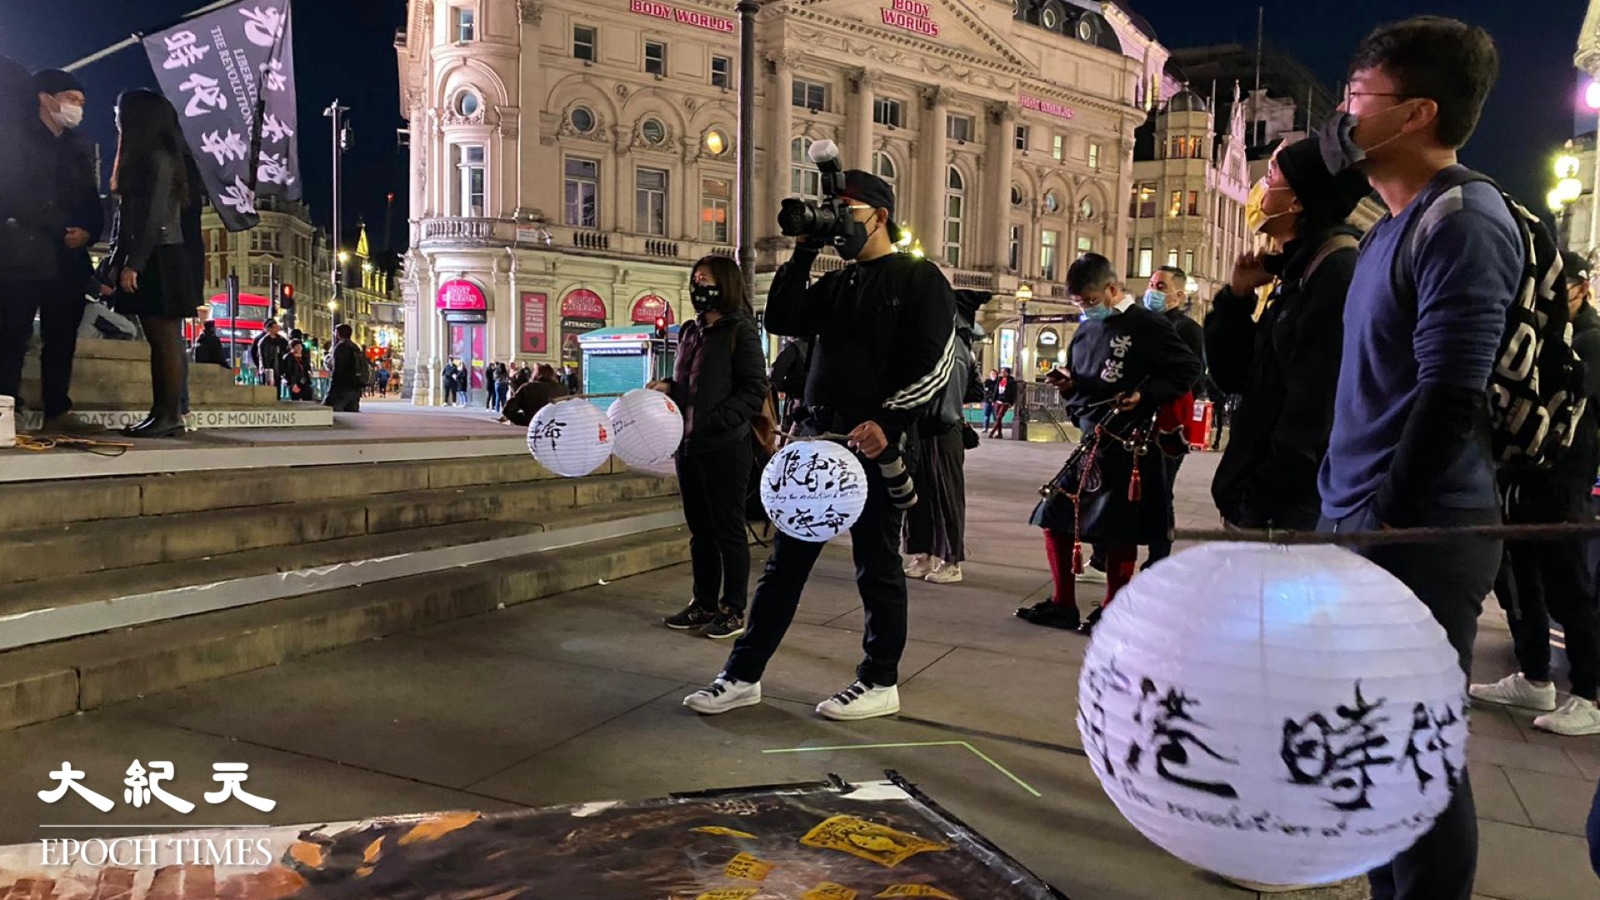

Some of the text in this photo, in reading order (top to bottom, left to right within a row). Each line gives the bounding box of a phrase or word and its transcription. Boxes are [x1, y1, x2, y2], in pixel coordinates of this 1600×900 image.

[631, 0, 735, 33] BODY WORLDS
[882, 8, 940, 37] WORLDS
[893, 0, 932, 18] BODY
[210, 25, 255, 126] THE REVOLUTION
[207, 413, 224, 425] OF
[228, 413, 296, 425] MOUNTAINS
